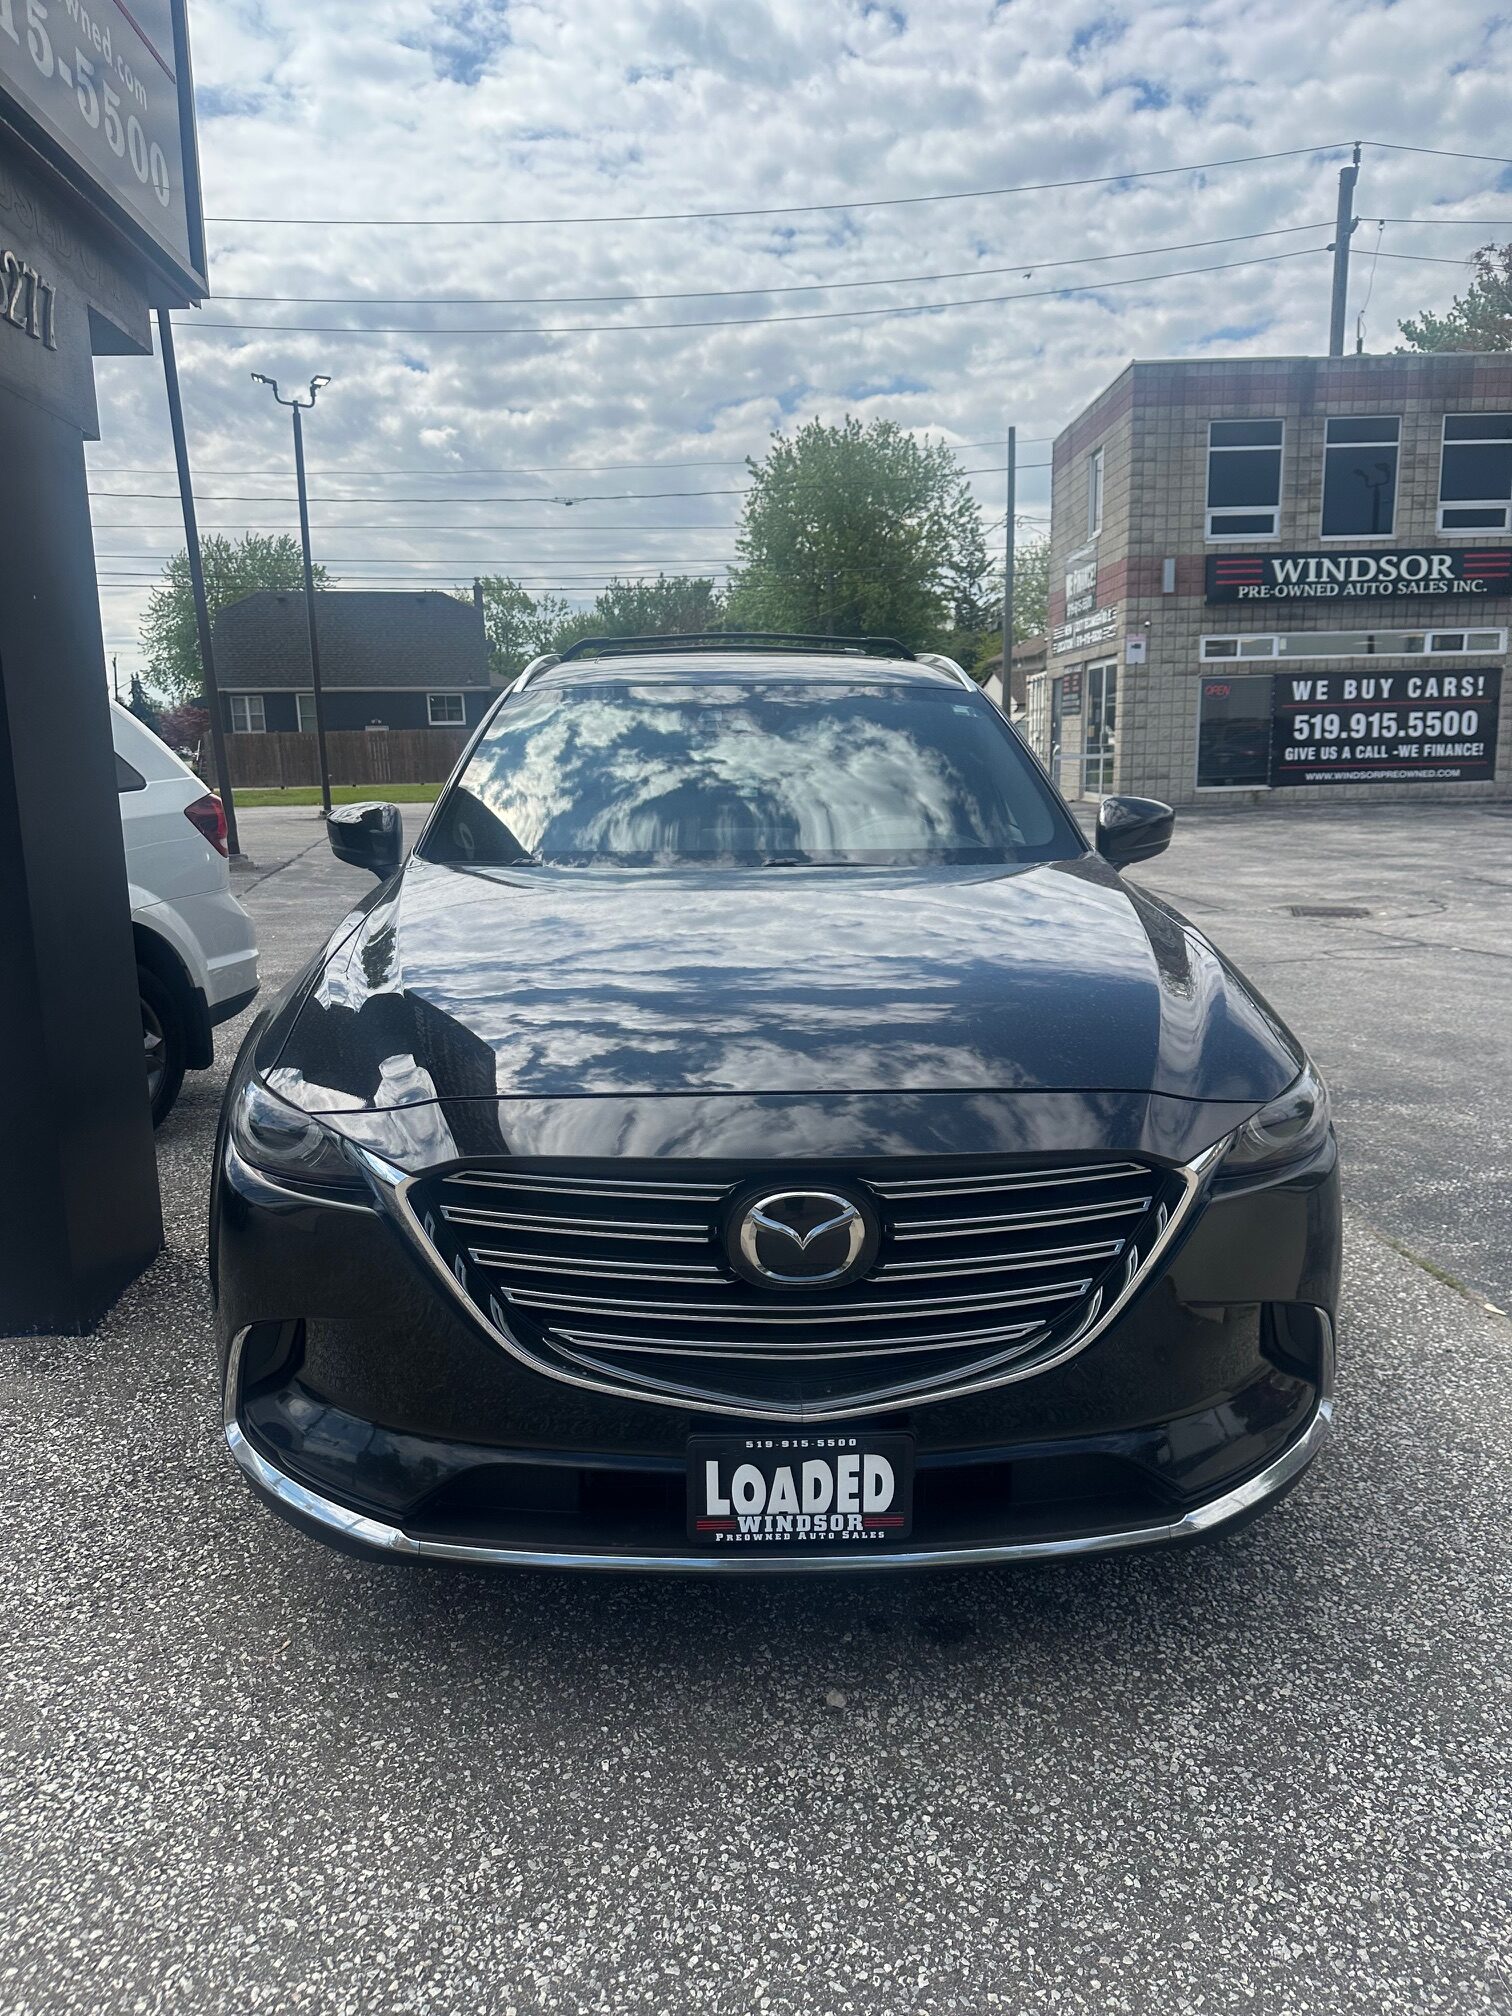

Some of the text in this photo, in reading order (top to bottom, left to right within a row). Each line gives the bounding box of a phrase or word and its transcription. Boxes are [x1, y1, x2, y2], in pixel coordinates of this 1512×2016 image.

[58, 0, 147, 111] wned.com
[1271, 555, 1455, 583] WINDSOR
[1238, 579, 1488, 598] PRE-OWNED AUTO SALES INC.
[1205, 685, 1231, 696] OPEN
[1292, 676, 1485, 701] WE BUY CARS!
[1293, 710, 1479, 740] 519.915.5500
[1285, 743, 1485, 761] GIVE US A CALL -WE FINANCE!
[1305, 769, 1461, 780] WWW.WINDSORPREOWNED.COM
[745, 1438, 857, 1448] 519-915-5500
[705, 1454, 895, 1516] LOADED
[737, 1514, 864, 1533] WINDSOR
[715, 1530, 886, 1542] PREOWNED AUTO SALES
